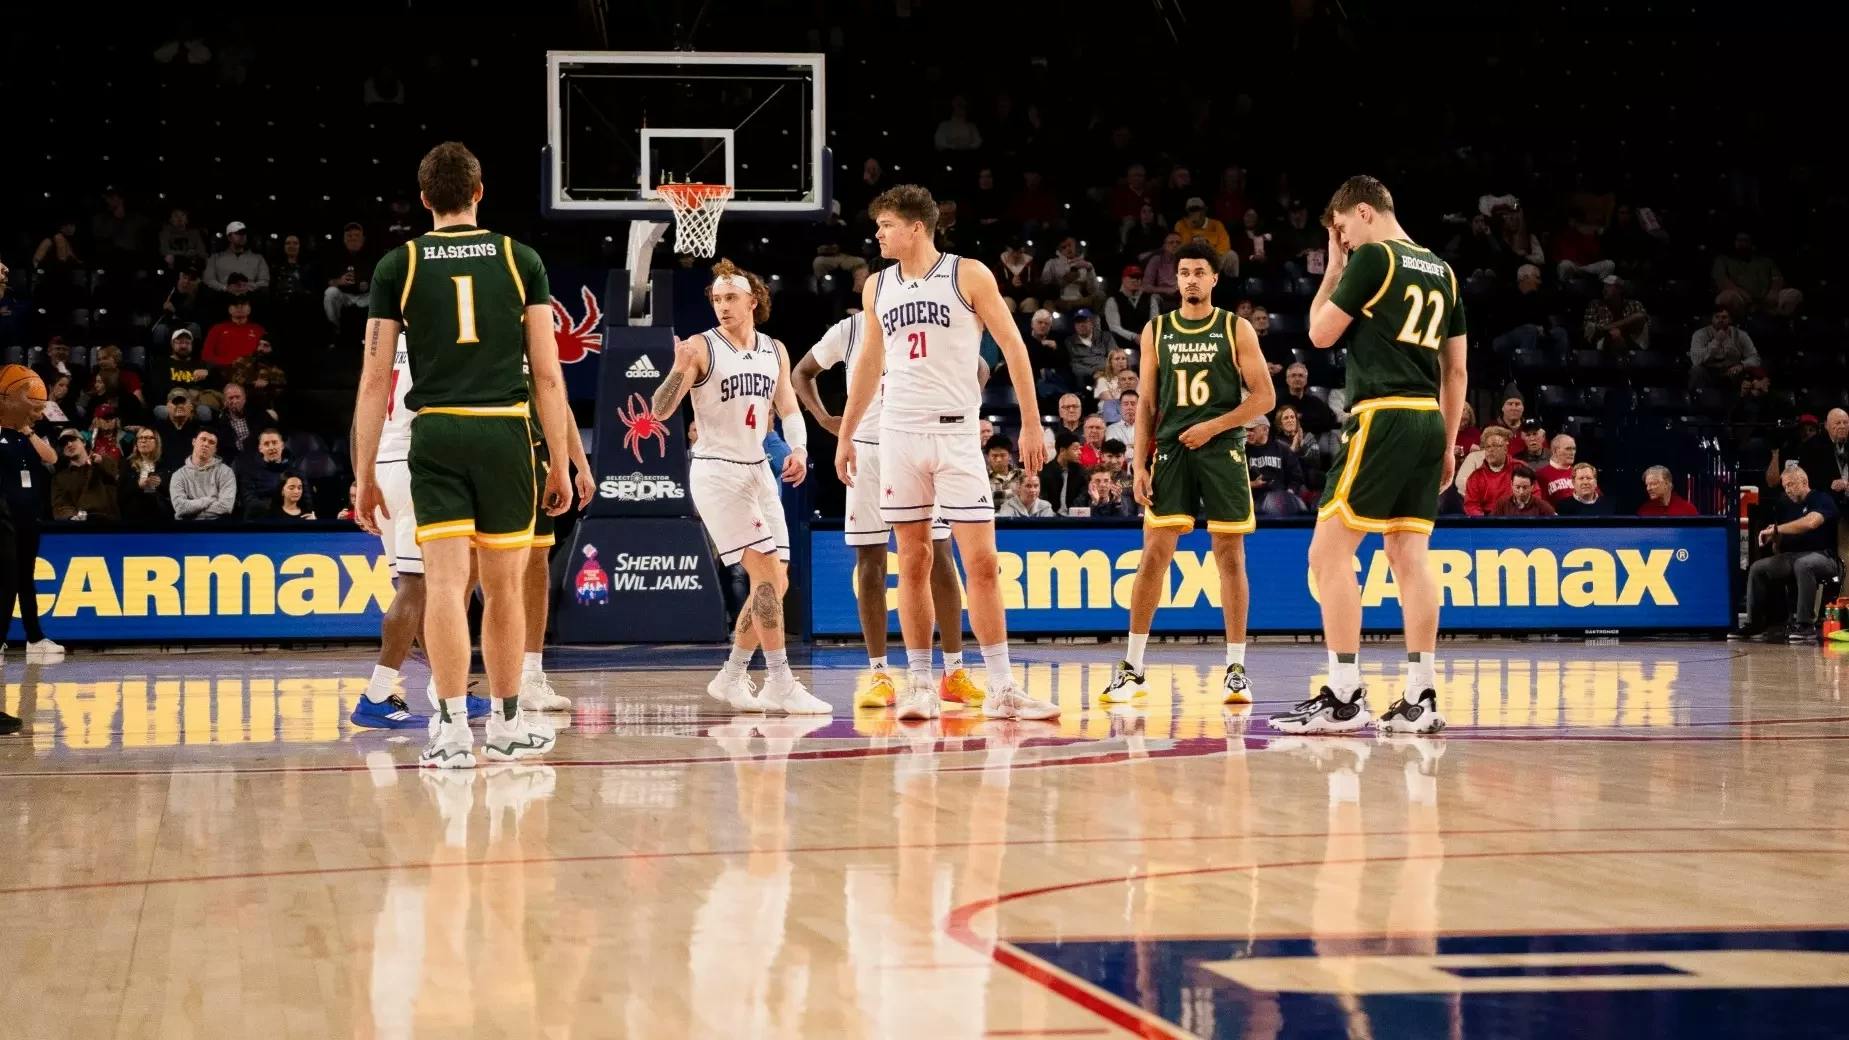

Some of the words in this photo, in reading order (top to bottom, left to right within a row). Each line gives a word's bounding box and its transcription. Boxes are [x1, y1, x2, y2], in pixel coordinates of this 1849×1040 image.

[423, 243, 497, 260] HASKINS
[450, 275, 480, 344] 1
[882, 300, 951, 336] SPIDERS
[1396, 284, 1445, 350] 22
[907, 331, 928, 360] 21
[1167, 342, 1219, 353] WILLIAM
[625, 370, 661, 378] adidas
[1174, 369, 1210, 407] 16
[745, 403, 757, 429] 4
